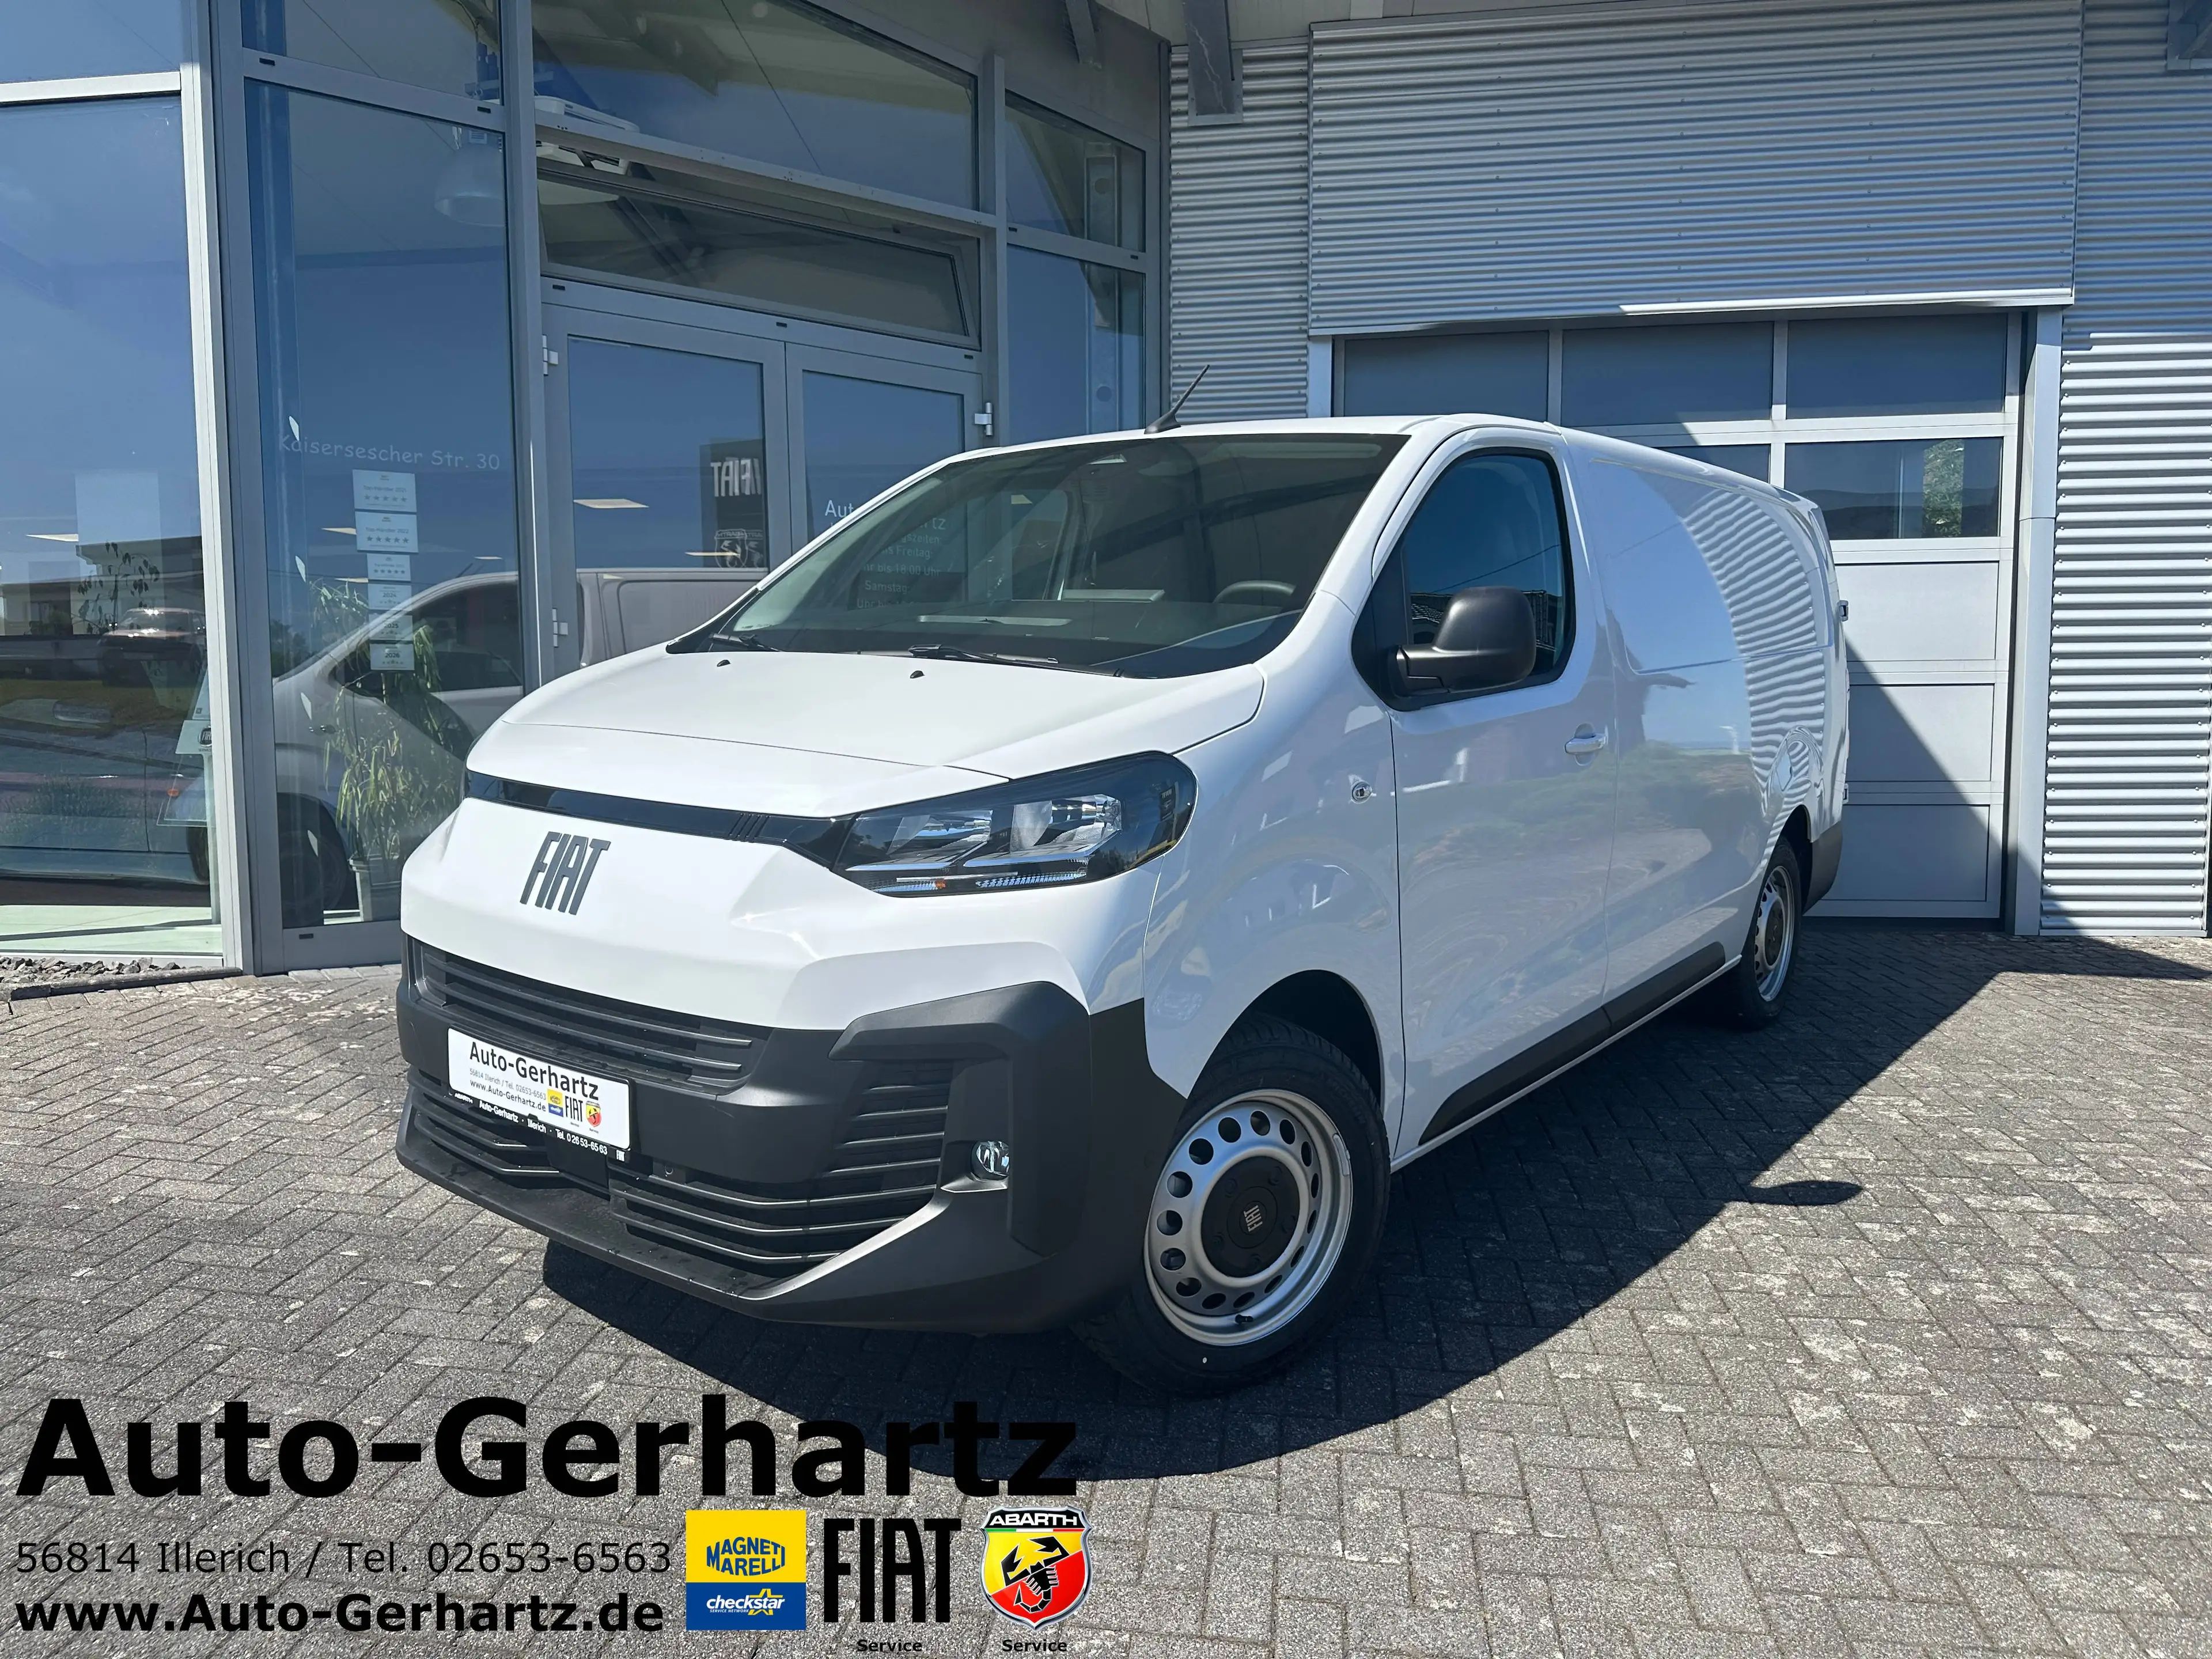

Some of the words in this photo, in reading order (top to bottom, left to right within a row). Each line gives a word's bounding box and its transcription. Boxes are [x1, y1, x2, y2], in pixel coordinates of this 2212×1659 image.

[278, 434, 423, 464] Kaisersescher
[431, 450, 469, 468] Str.
[476, 453, 499, 470] 30
[824, 499, 854, 518] Aut
[520, 831, 611, 915] FIAT
[469, 1041, 599, 1101] Auto-Gerhartz
[470, 1079, 546, 1112] www.Auto-Gerhartz.de
[565, 1095, 583, 1122] FIAT
[479, 1100, 519, 1123] Auto-Gerhartz
[527, 1118, 547, 1134] Illerich
[1243, 1205, 1263, 1233] FIAT
